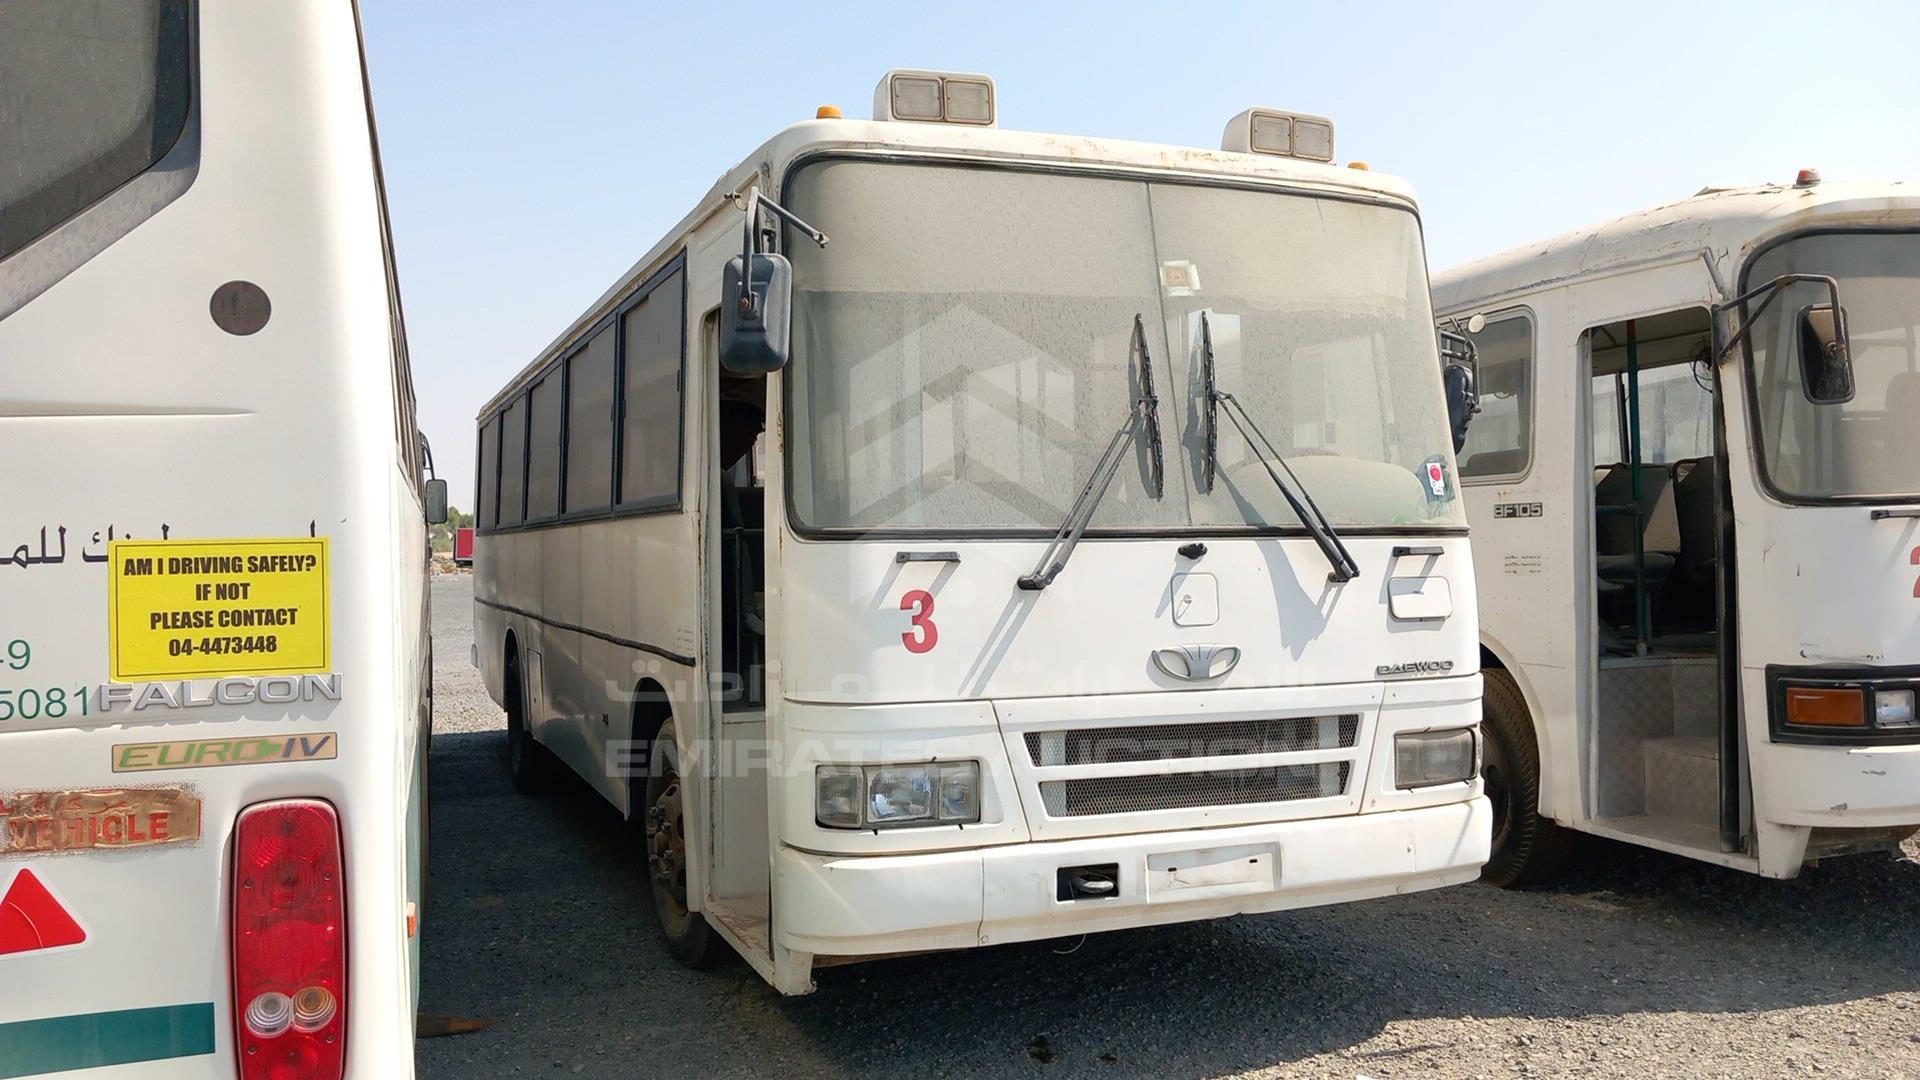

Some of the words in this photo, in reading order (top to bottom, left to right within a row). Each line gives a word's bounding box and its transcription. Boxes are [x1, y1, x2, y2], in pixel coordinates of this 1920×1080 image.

[1494, 503, 1542, 518] BF105
[124, 558, 152, 575] AM
[157, 558, 163, 575] I
[168, 556, 243, 575] DRIVING
[248, 554, 316, 573] SAFELY?
[196, 584, 212, 601] IF
[215, 582, 250, 600] NOT
[150, 611, 213, 630] PLEASE
[218, 608, 298, 627] CONTACT
[900, 590, 938, 653] 3
[169, 636, 277, 656] 04-4473448
[1376, 660, 1454, 676] DAEWOO
[99, 673, 342, 712] FALCON
[9, 812, 169, 848] VEHICLE
